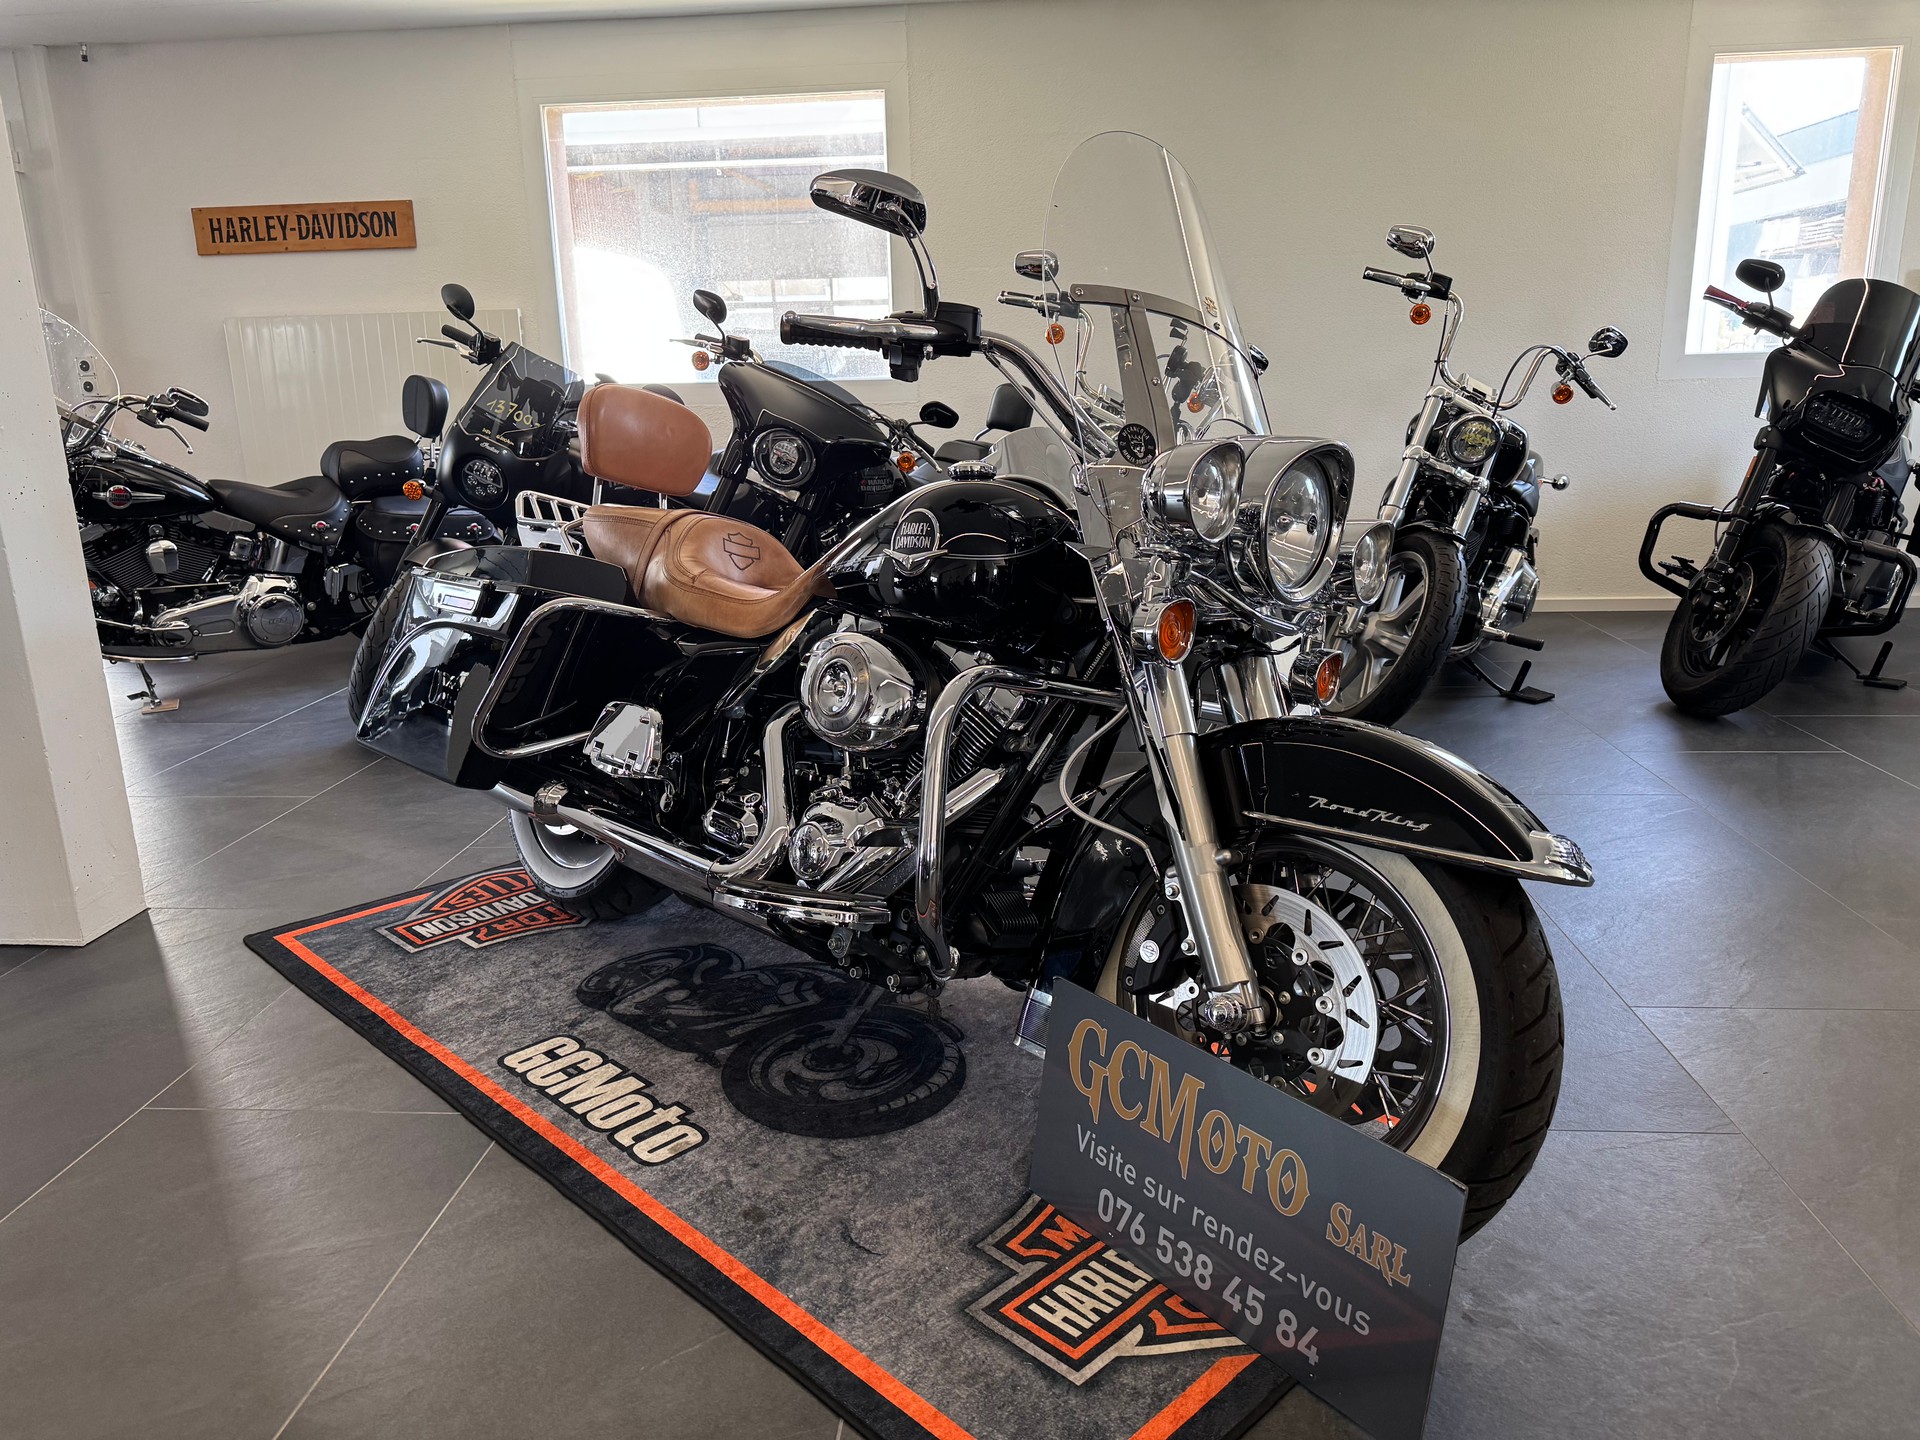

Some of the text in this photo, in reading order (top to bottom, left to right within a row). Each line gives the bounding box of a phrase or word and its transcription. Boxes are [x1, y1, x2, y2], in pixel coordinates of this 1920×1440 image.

[208, 211, 398, 244] HARLEY-DAVIDSON
[895, 536, 931, 549] DAVIDSON
[901, 522, 931, 535] HARLEY-
[411, 892, 547, 938] DAVIDSON
[503, 1036, 703, 1163] GCMoto
[1077, 1123, 1371, 1336] Visite sur rendez-vous
[1098, 1188, 1146, 1246] 076
[1156, 1225, 1214, 1291] 538
[1222, 1275, 1266, 1326] 45
[1275, 1308, 1320, 1366] 84
